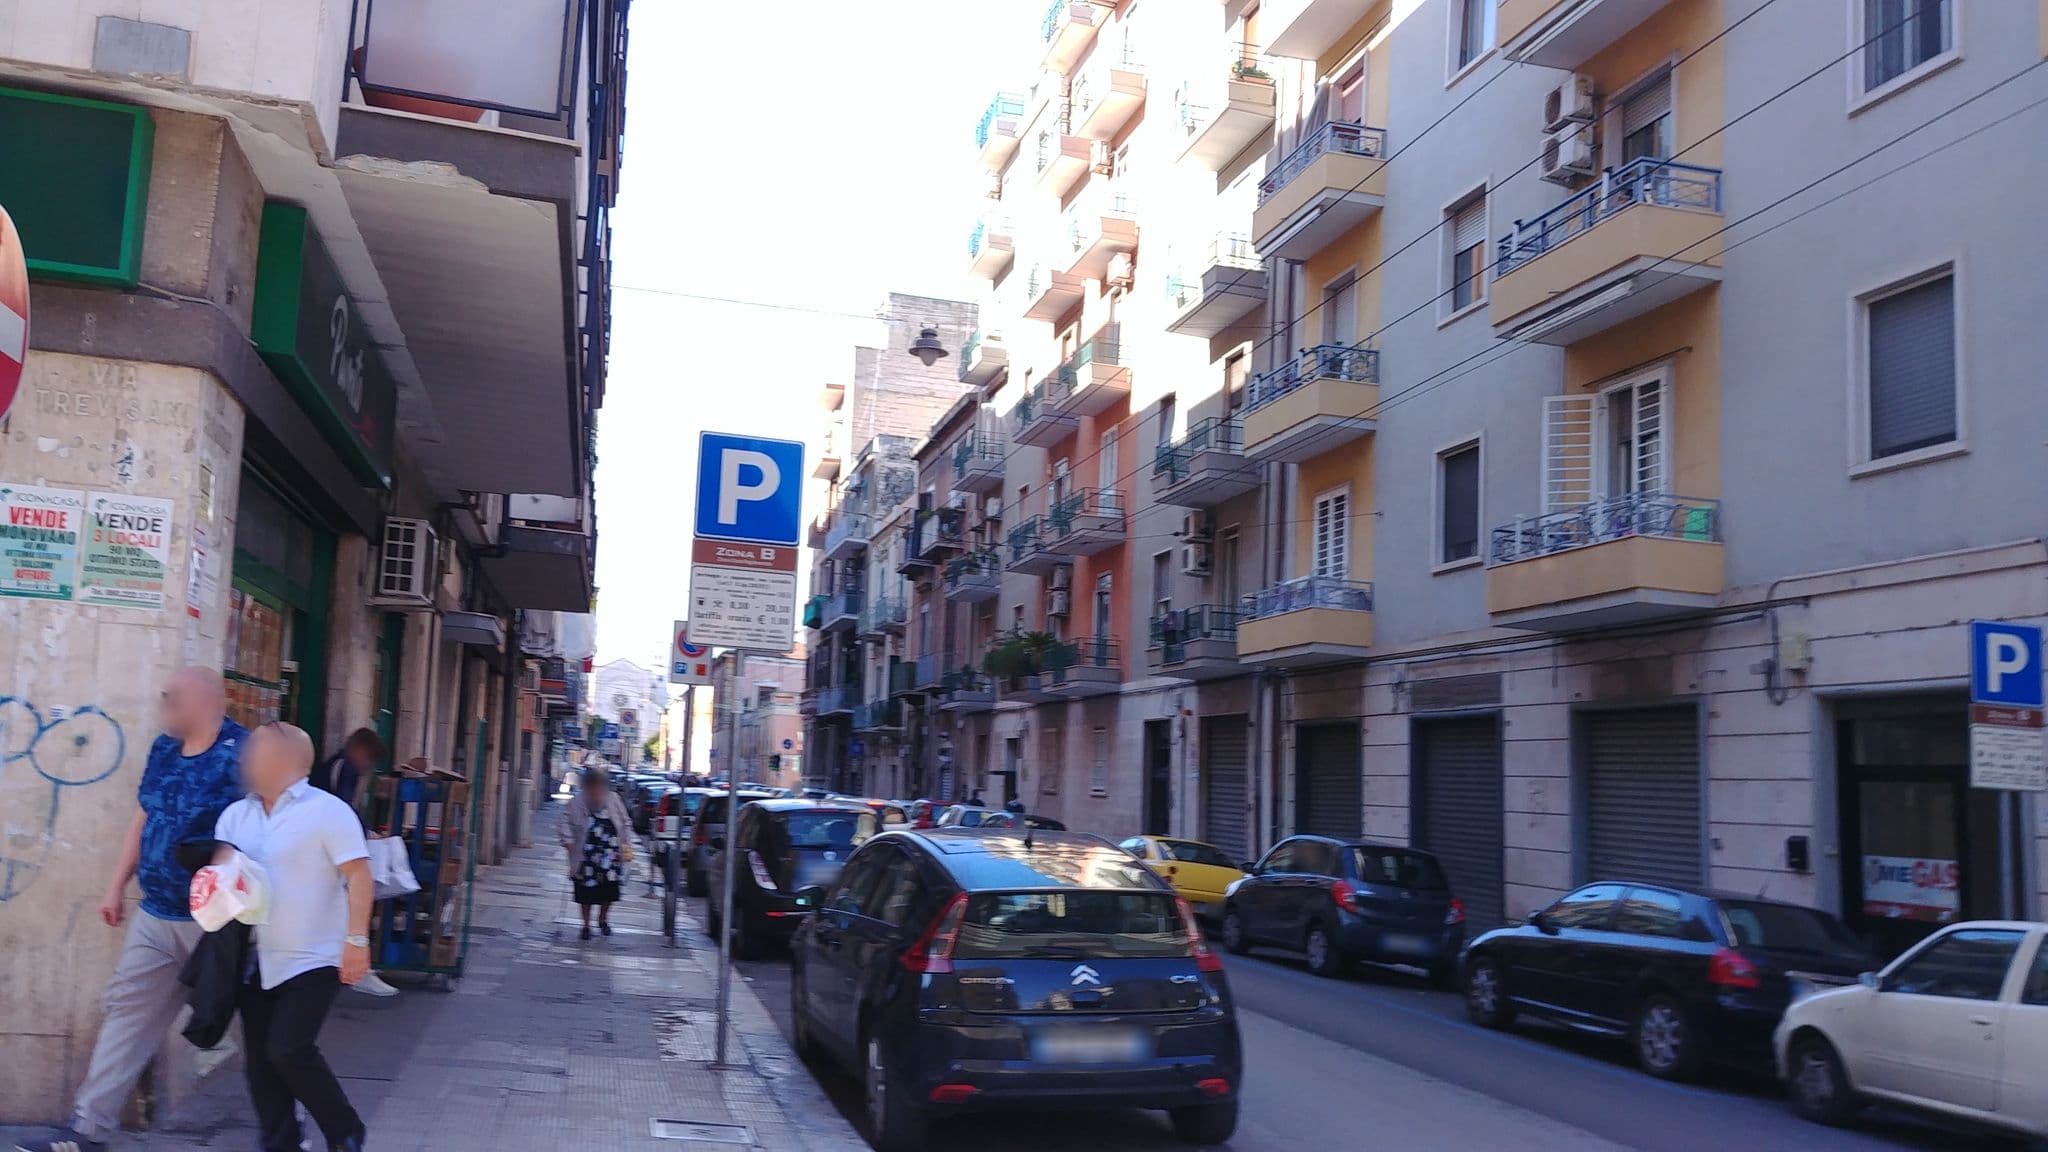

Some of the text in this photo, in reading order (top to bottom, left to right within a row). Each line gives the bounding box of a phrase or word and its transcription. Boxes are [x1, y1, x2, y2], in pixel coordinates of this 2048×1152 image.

[91, 362, 137, 391] VIA
[717, 447, 782, 525] P
[9, 506, 68, 529] VENDE
[94, 512, 164, 533] VENDE
[93, 528, 162, 549] 3 LOCALI
[715, 546, 776, 561] ZONA B
[1986, 632, 2029, 694] P
